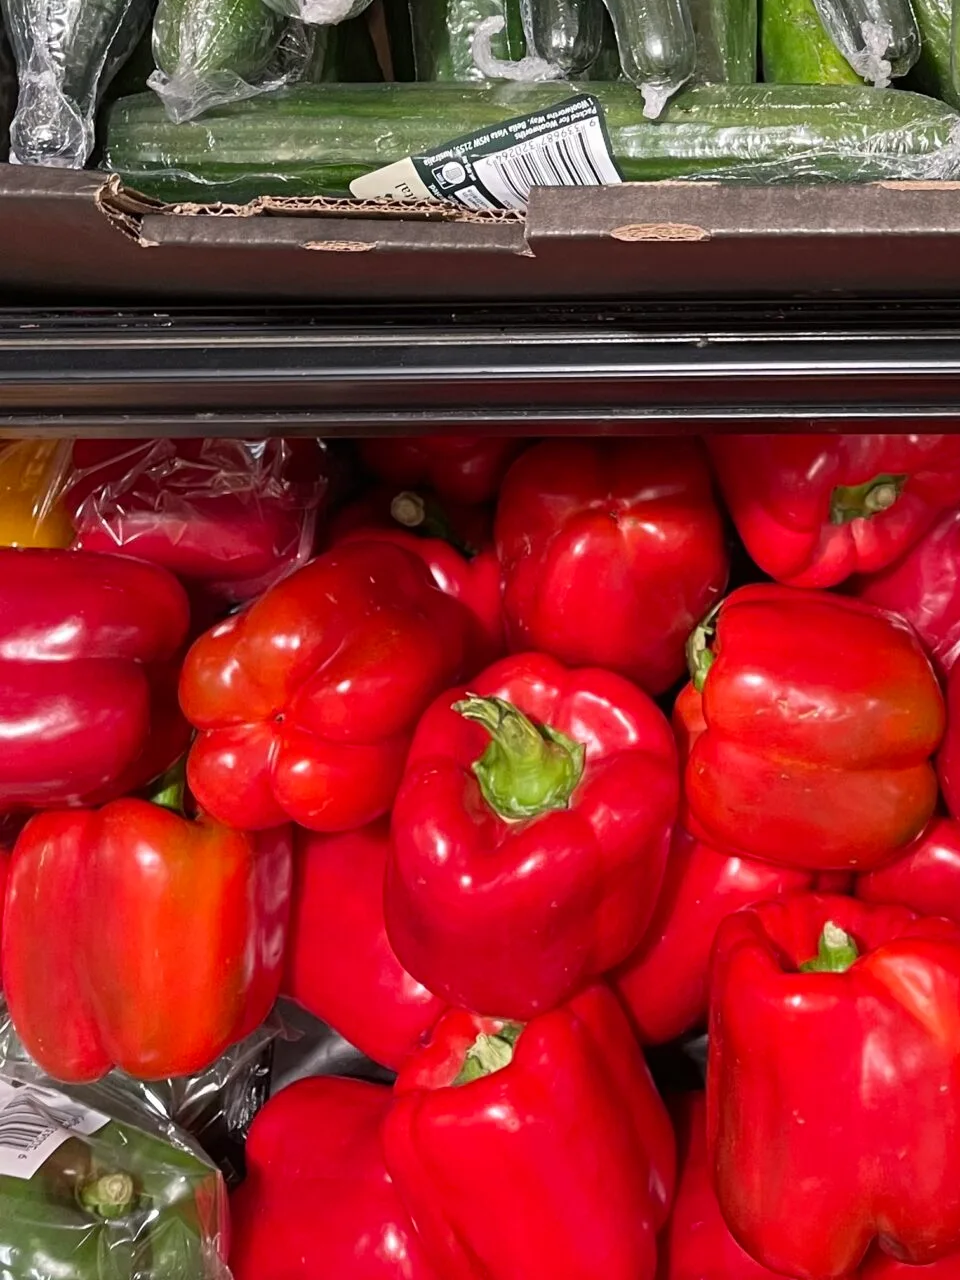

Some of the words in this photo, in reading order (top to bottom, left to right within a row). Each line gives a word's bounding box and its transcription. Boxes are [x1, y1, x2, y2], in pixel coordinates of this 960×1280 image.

[547, 100, 589, 119] Woolworths
[571, 106, 597, 121] Packed
[508, 121, 527, 132] Bella
[527, 116, 546, 125] Way,
[490, 128, 509, 139] Vista
[514, 120, 558, 140] Woolworths
[539, 123, 582, 146] 339687
[473, 134, 490, 148] NSW
[423, 149, 455, 166] Australia
[494, 140, 536, 163] 320264
